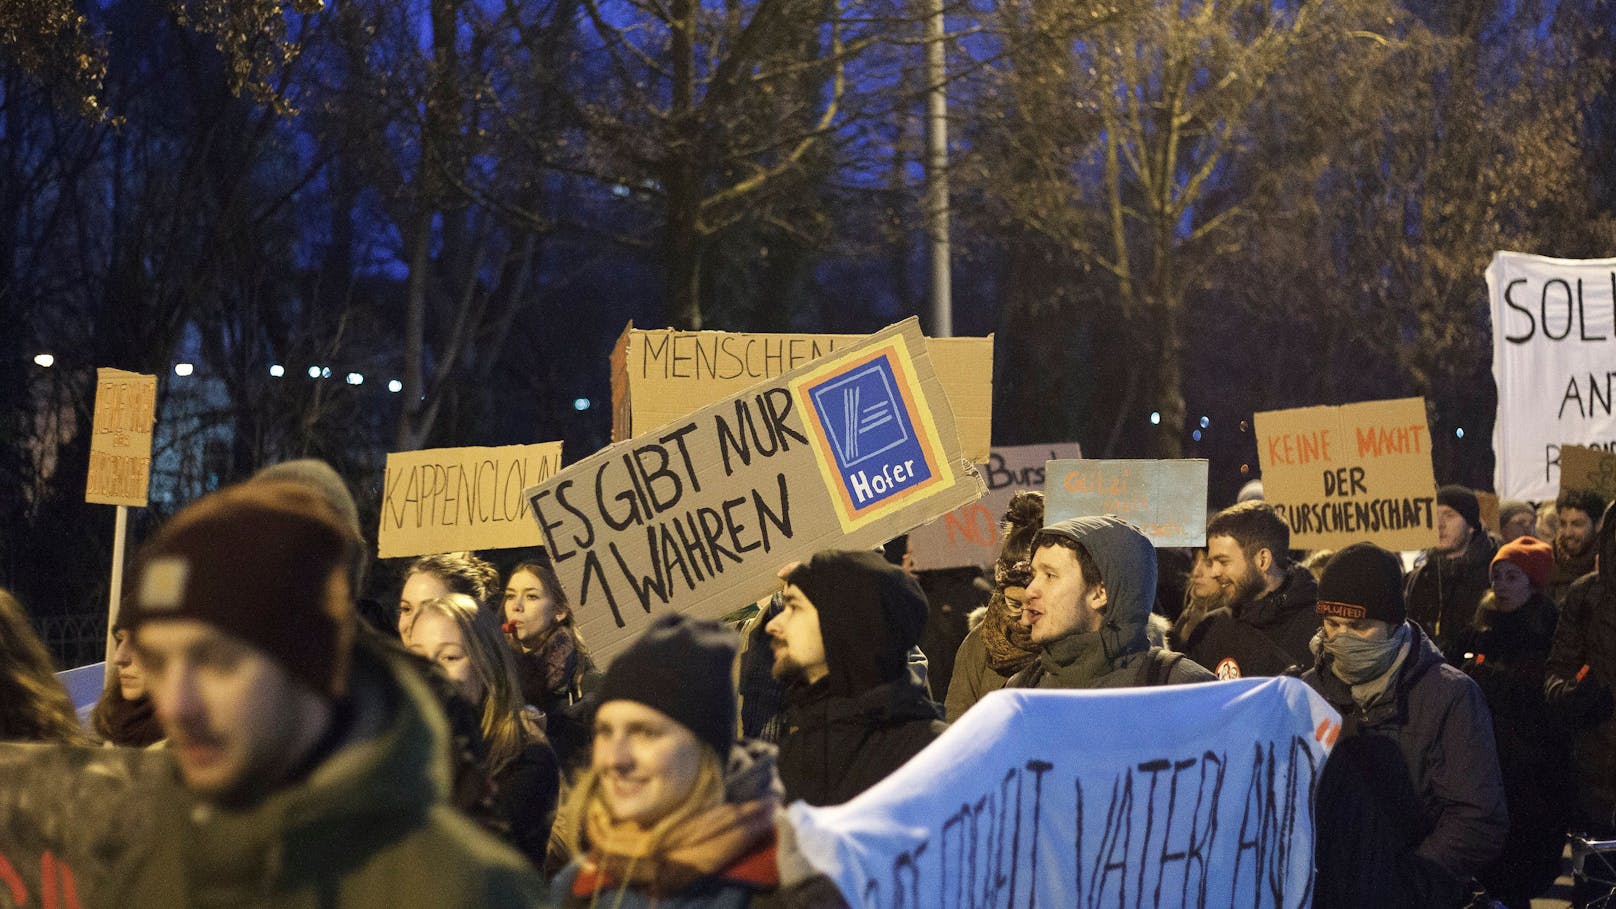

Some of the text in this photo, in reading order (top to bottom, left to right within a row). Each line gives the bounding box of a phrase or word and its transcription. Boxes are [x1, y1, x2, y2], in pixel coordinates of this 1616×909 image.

[1557, 370, 1616, 420] AN
[1267, 424, 1425, 467] KEINE MACHT
[529, 386, 810, 563] ES GIBT NUR
[849, 459, 914, 504] Hofer
[1322, 466, 1368, 497] DER
[609, 473, 794, 614] WAHREN
